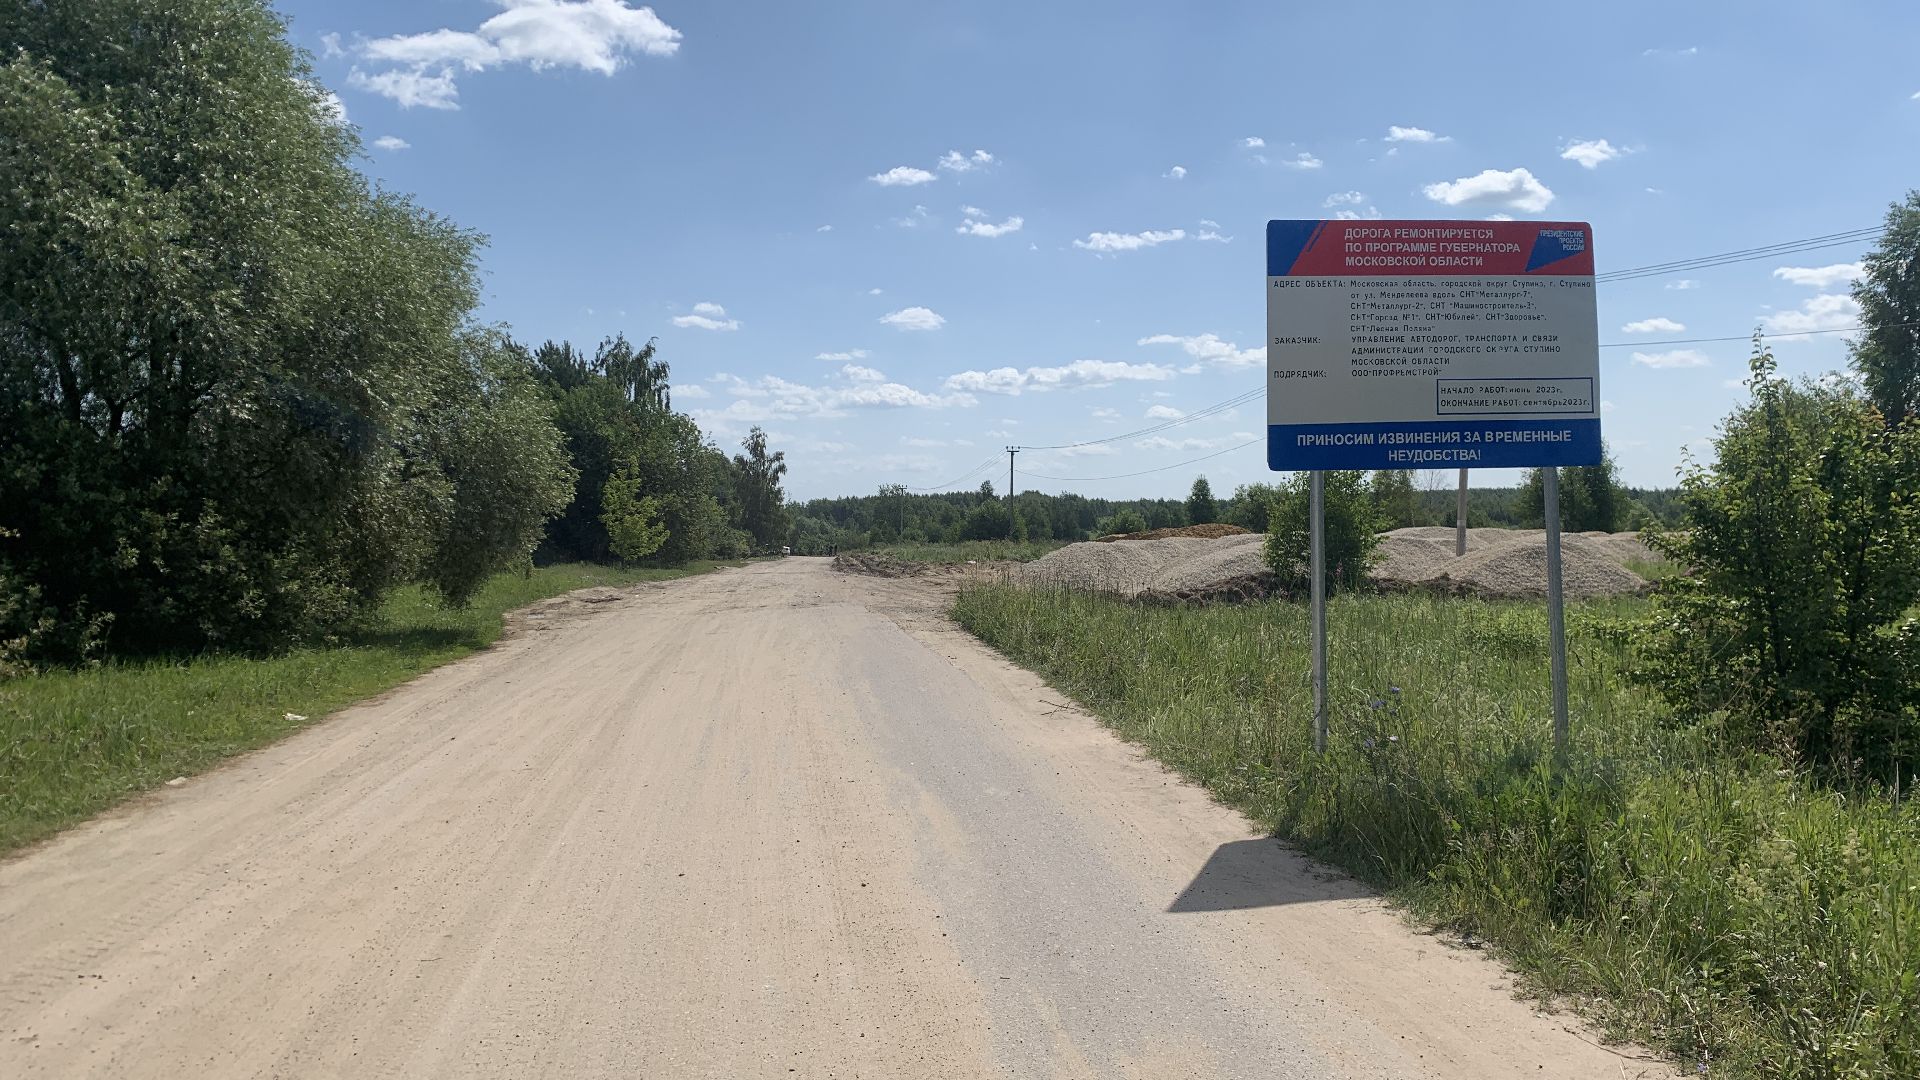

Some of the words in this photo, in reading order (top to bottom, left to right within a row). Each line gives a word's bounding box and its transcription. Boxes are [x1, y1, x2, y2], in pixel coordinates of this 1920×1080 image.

[1344, 228, 1391, 240] ДОРОГА
[1395, 228, 1493, 239] РЕМОНТИРУЕТСЯ
[1345, 243, 1362, 253] ПО
[1365, 243, 1436, 253] ПРОГРАММЕ
[1439, 242, 1521, 253] ГУБЕРНАТОРА
[1345, 255, 1425, 267] МОСКОВСКОЙ
[1429, 256, 1483, 267] ОБЛАСТИ
[1274, 280, 1300, 288] АДРЕС
[1305, 280, 1346, 288] ОБЪЕКТА:
[1350, 280, 1399, 288] Московская
[1486, 280, 1508, 289] округ
[1559, 280, 1591, 289] Ступино
[1380, 291, 1429, 299] Менделеева
[1432, 291, 1456, 299] вдоль
[1430, 301, 1446, 309] СНТ
[1274, 336, 1321, 345] ЗАКАЗЧИК:
[1465, 335, 1517, 343] ТРАНСПОРТА
[1522, 335, 1528, 343] И
[1532, 335, 1558, 343] СВЯЗИ
[1351, 347, 1424, 355] АДМИНИСТРАЦИИ
[1351, 357, 1407, 366] МОСКОВСКОЙ
[1411, 357, 1450, 365] ОБЛАСТИ
[1273, 370, 1327, 379] ПОДРЯДЧИК:
[1440, 386, 1474, 395] НАЧАЛО
[1440, 399, 1489, 407] ОКОНЧАНИЕ
[1297, 434, 1374, 446] ПРИНОСИМ
[1378, 432, 1461, 445] ИЗВИНЕНИЯ
[1464, 432, 1481, 443] ЗА
[1485, 430, 1572, 443] ВРЕМЕННЫЕ
[1388, 450, 1481, 462] НЕУДОБСТВА!
